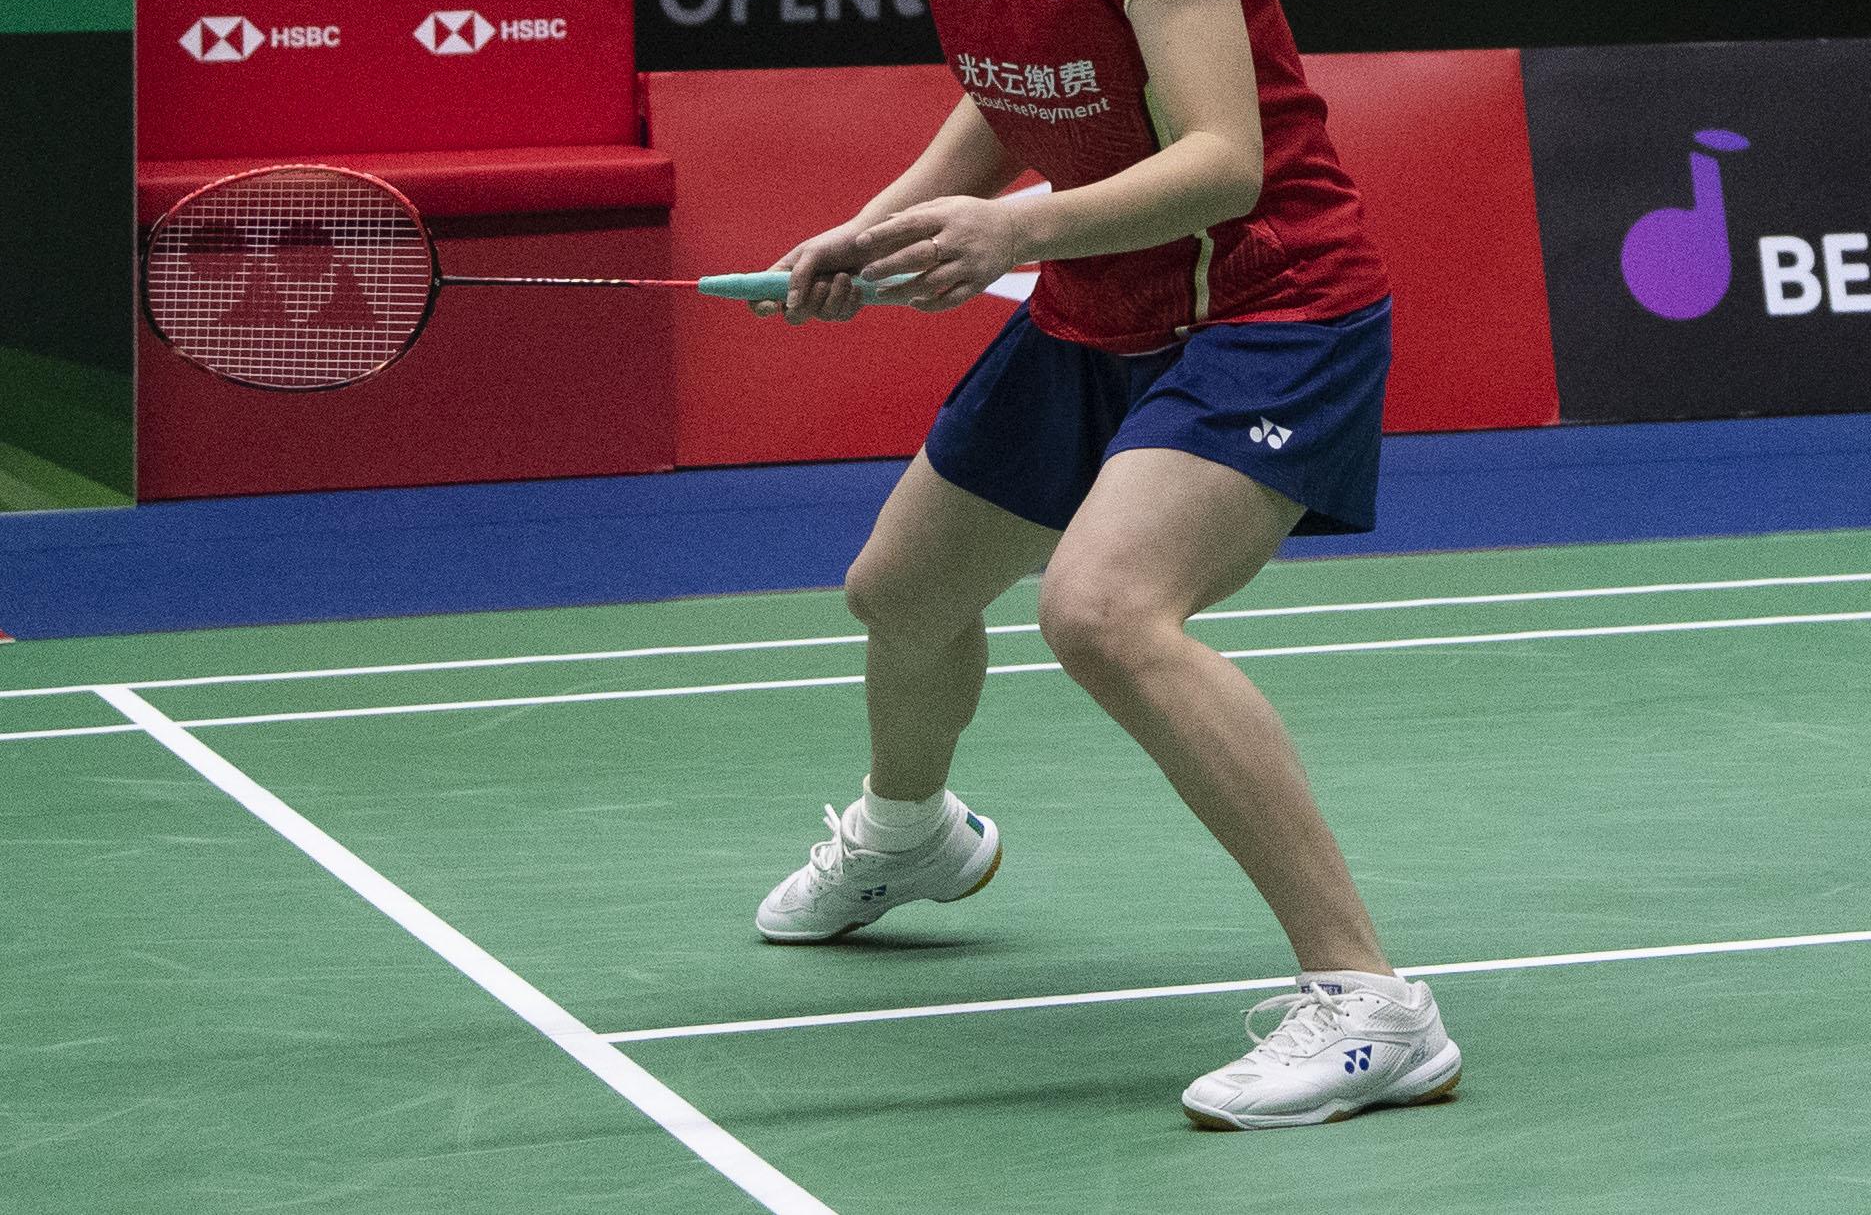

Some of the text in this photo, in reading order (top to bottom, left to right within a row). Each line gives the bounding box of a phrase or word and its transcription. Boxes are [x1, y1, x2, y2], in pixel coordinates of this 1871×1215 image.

[270, 25, 342, 49] HSBC
[500, 17, 568, 41] HSBC
[957, 52, 1101, 99] 光大云缴费
